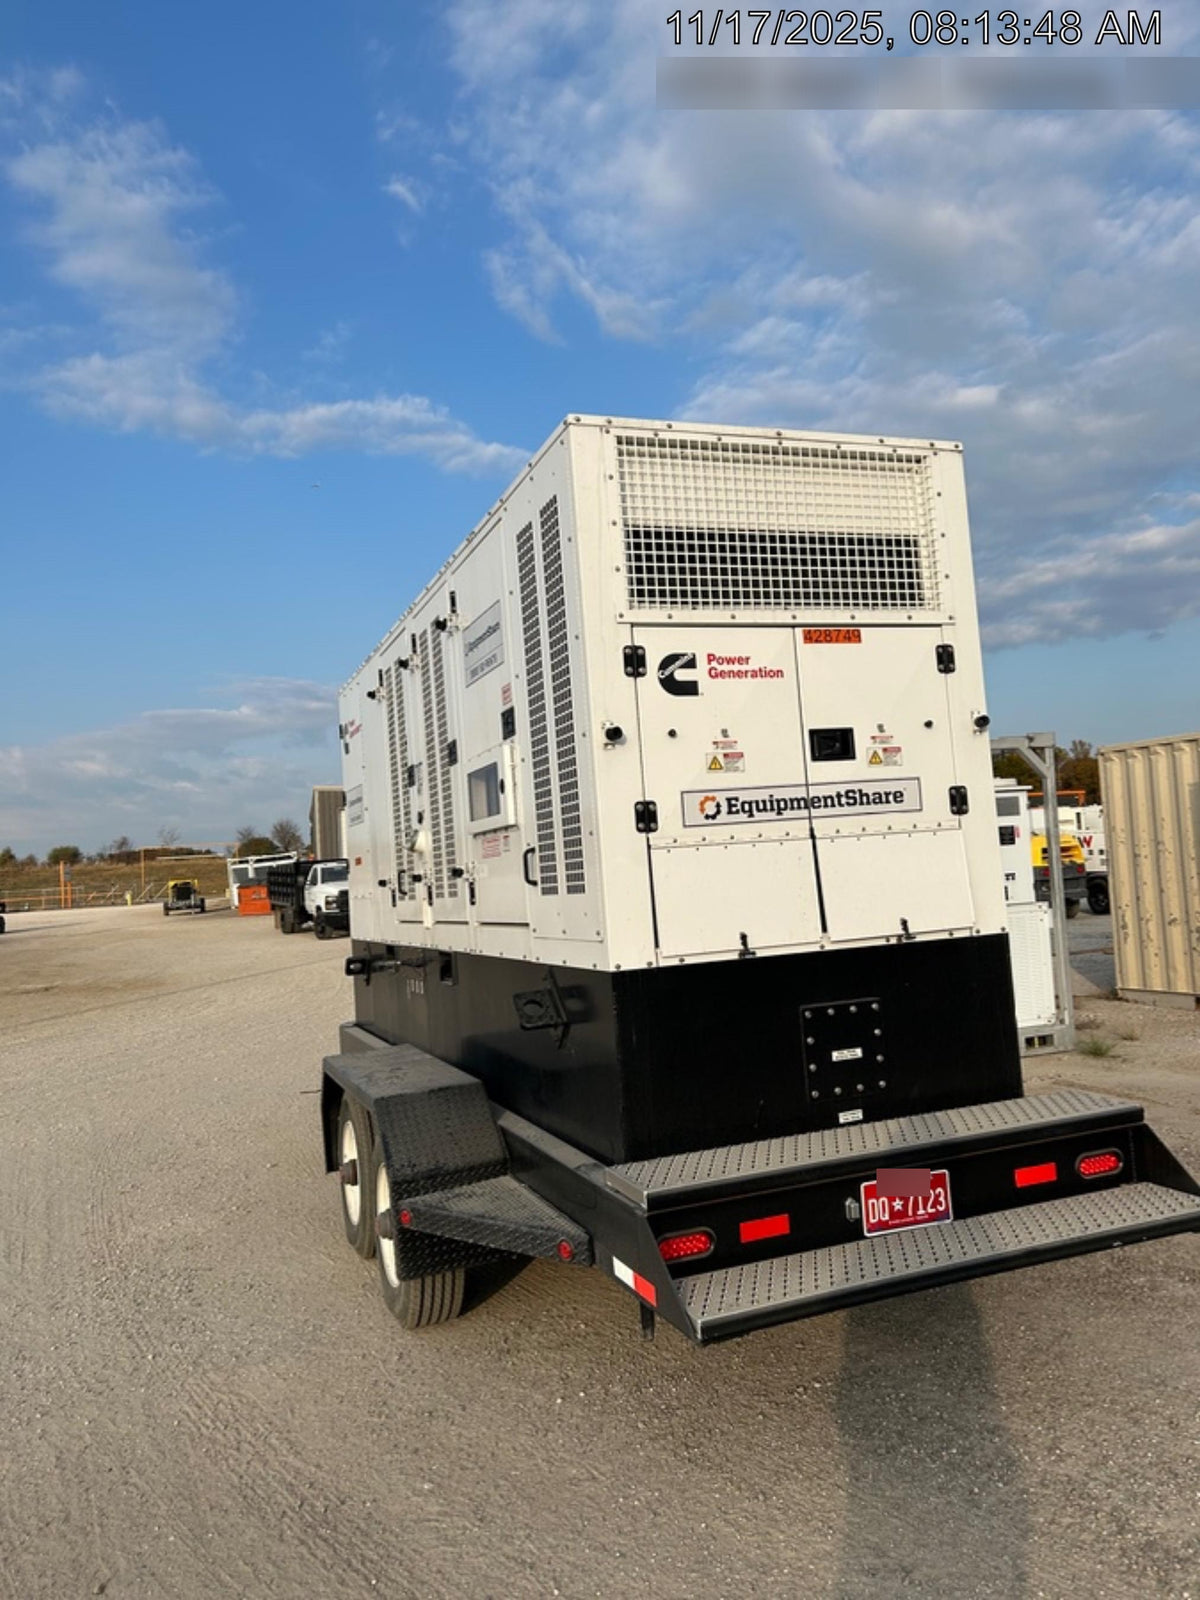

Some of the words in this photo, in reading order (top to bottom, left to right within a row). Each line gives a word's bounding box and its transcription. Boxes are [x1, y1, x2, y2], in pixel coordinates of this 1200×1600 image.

[803, 629, 861, 643] 428749
[707, 653, 750, 665] Power
[708, 666, 784, 679] Generation
[725, 788, 904, 818] EquipmentShare
